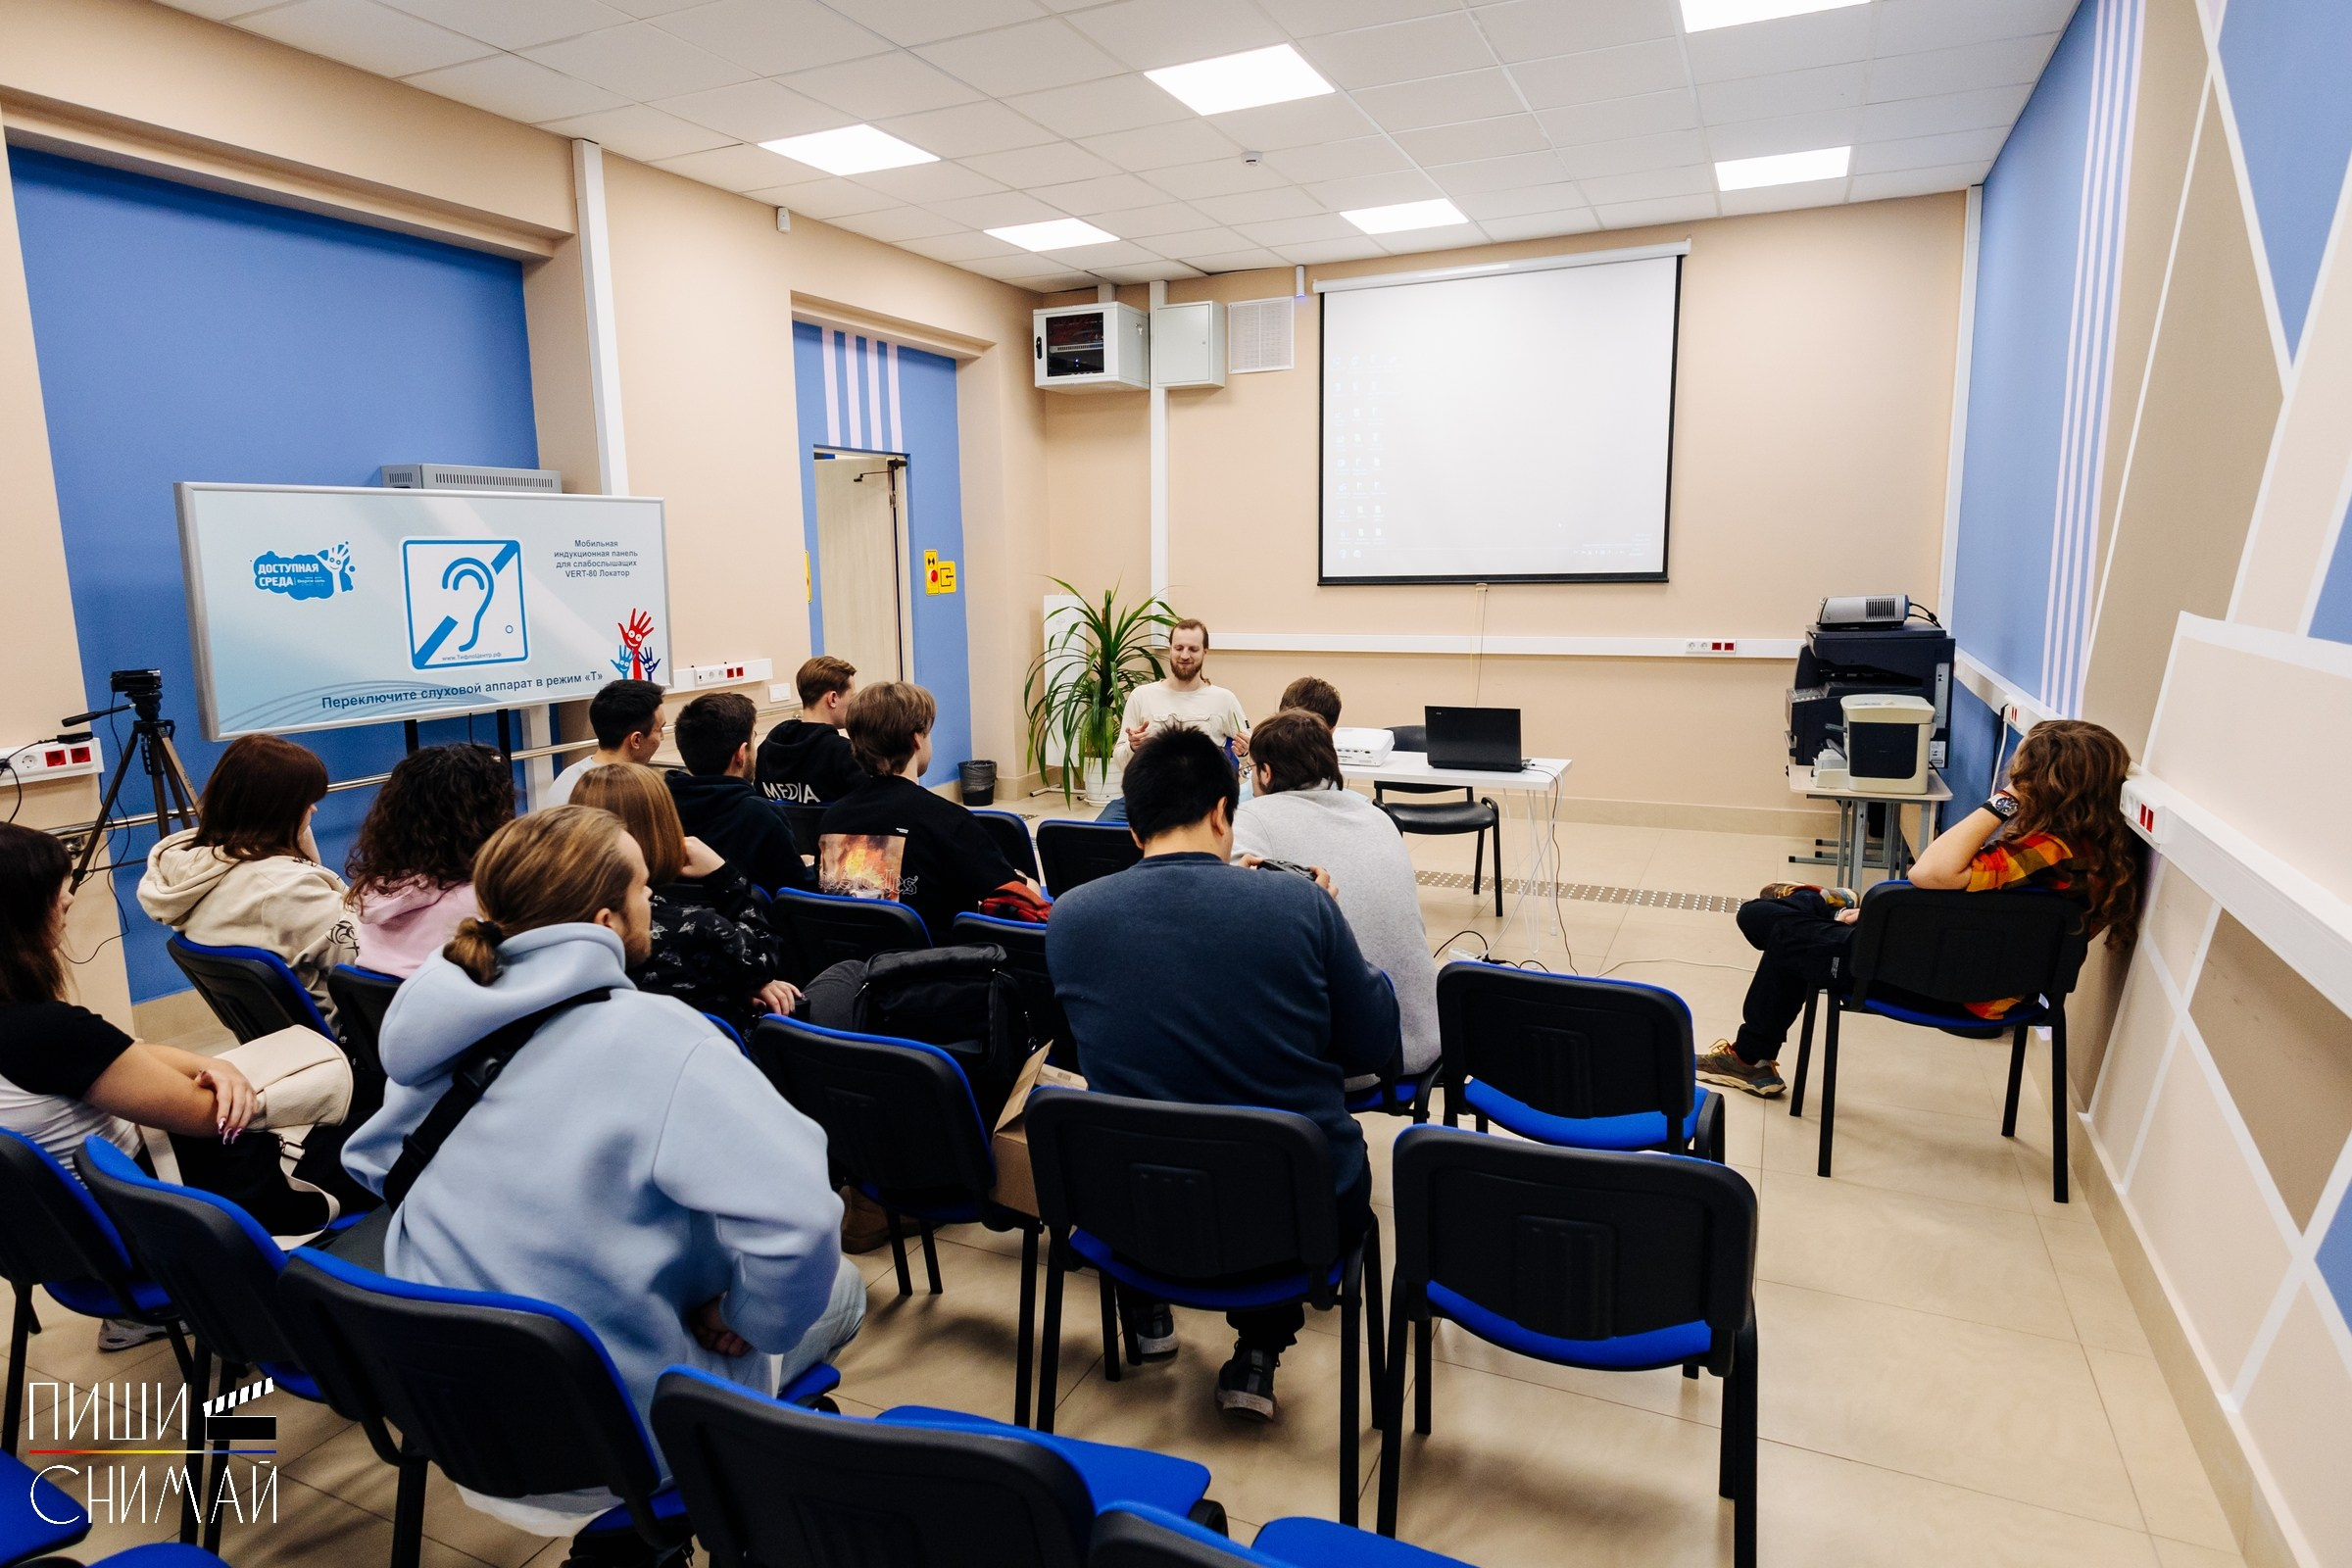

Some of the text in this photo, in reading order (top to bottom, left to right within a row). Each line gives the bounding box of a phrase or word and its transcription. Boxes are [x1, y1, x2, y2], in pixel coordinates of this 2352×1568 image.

[574, 539, 618, 548] Мобильная
[554, 550, 610, 559] индукционная
[573, 559, 637, 567] слабослышащих
[258, 564, 319, 574] ДОСТУПНАЯ
[259, 577, 293, 587] СРЕДА
[321, 690, 416, 710] Переключите
[420, 682, 482, 700] слуховой
[485, 679, 532, 692] аппарат
[547, 674, 581, 688] режим
[761, 781, 821, 804] MEDIA
